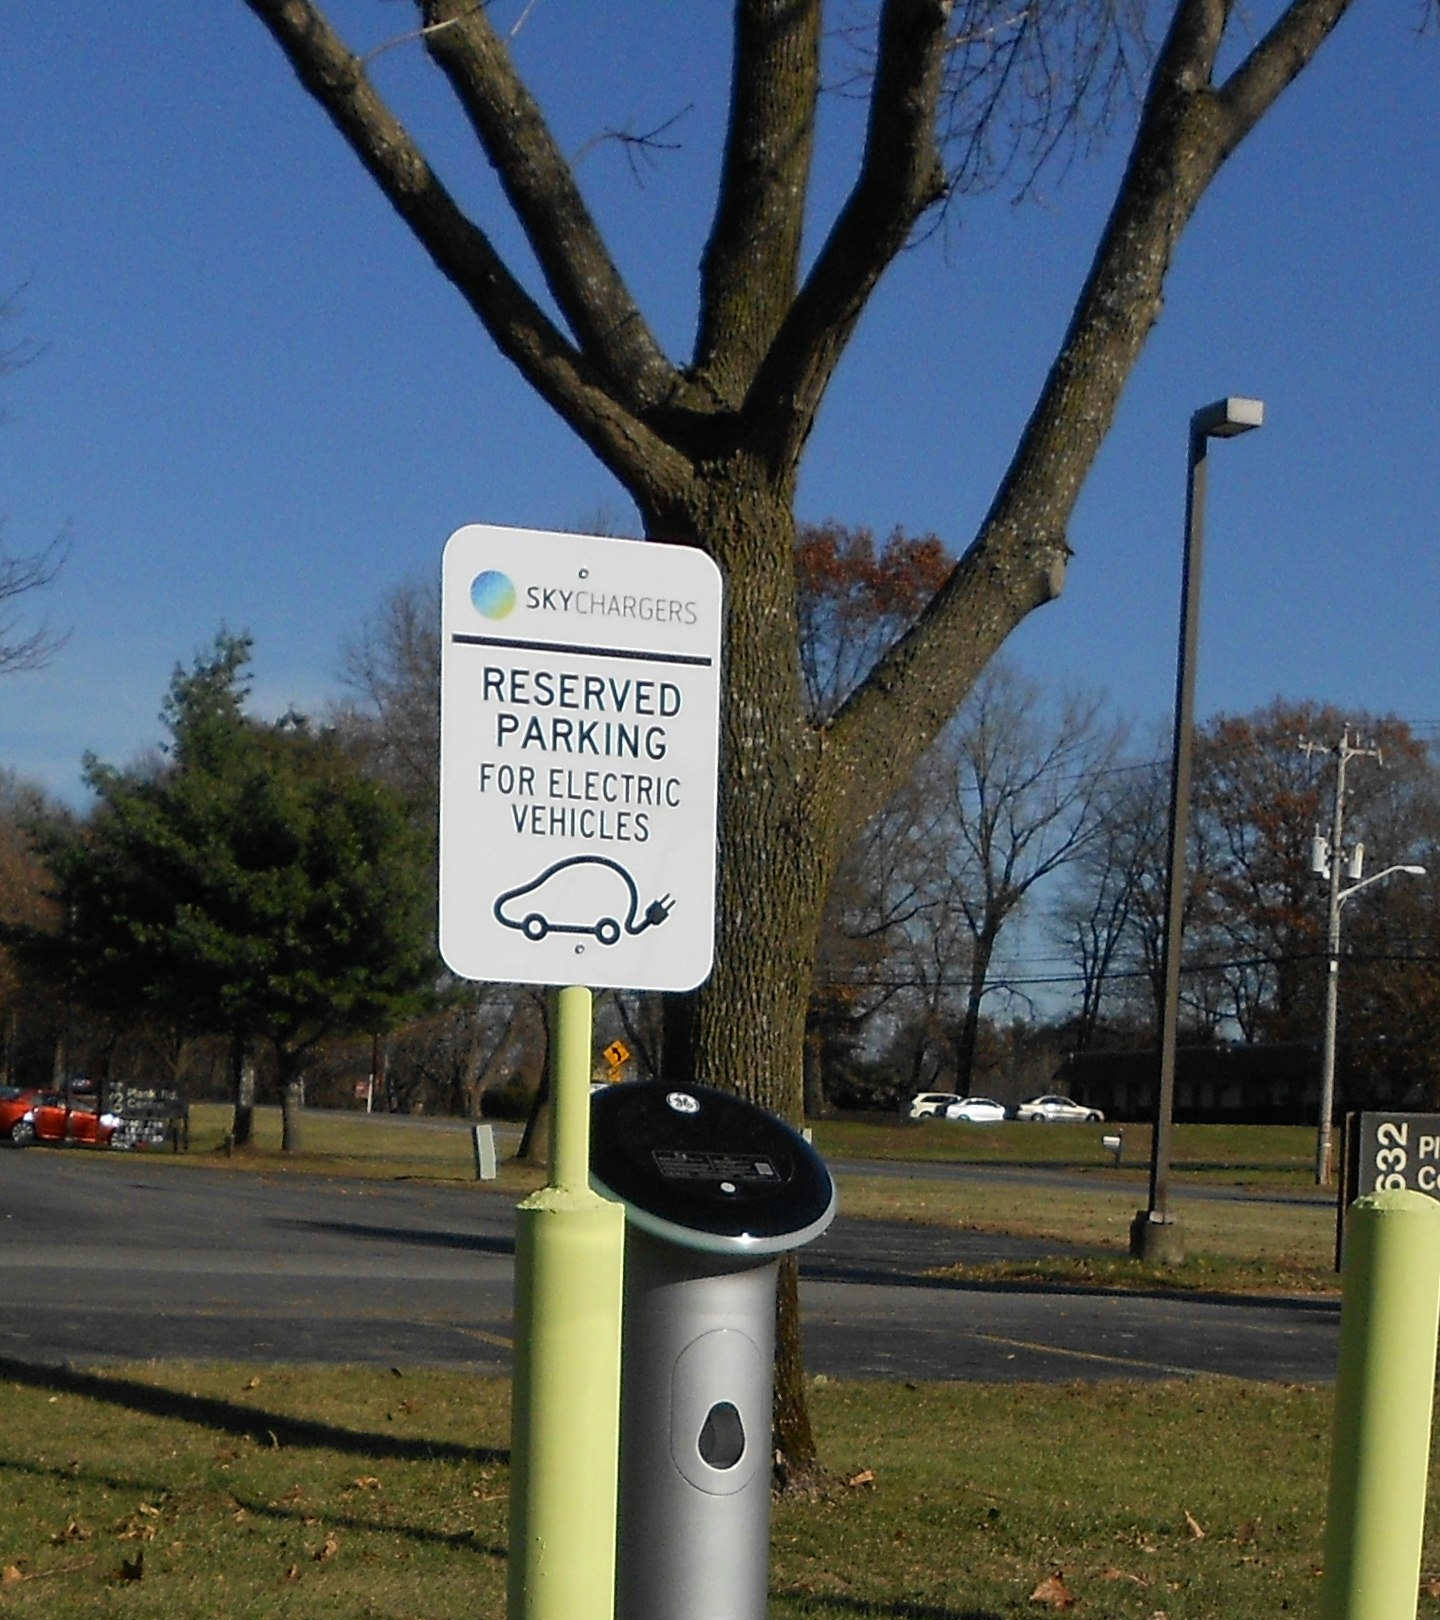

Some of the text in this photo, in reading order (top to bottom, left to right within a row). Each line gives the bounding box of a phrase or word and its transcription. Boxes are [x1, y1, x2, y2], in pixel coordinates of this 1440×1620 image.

[526, 586, 698, 626] SKYCHARGERS
[483, 666, 682, 717] RESERVED
[497, 713, 668, 760] PARKING
[480, 763, 681, 808] FOR ELECTRIC
[512, 804, 650, 842] VEHICLES
